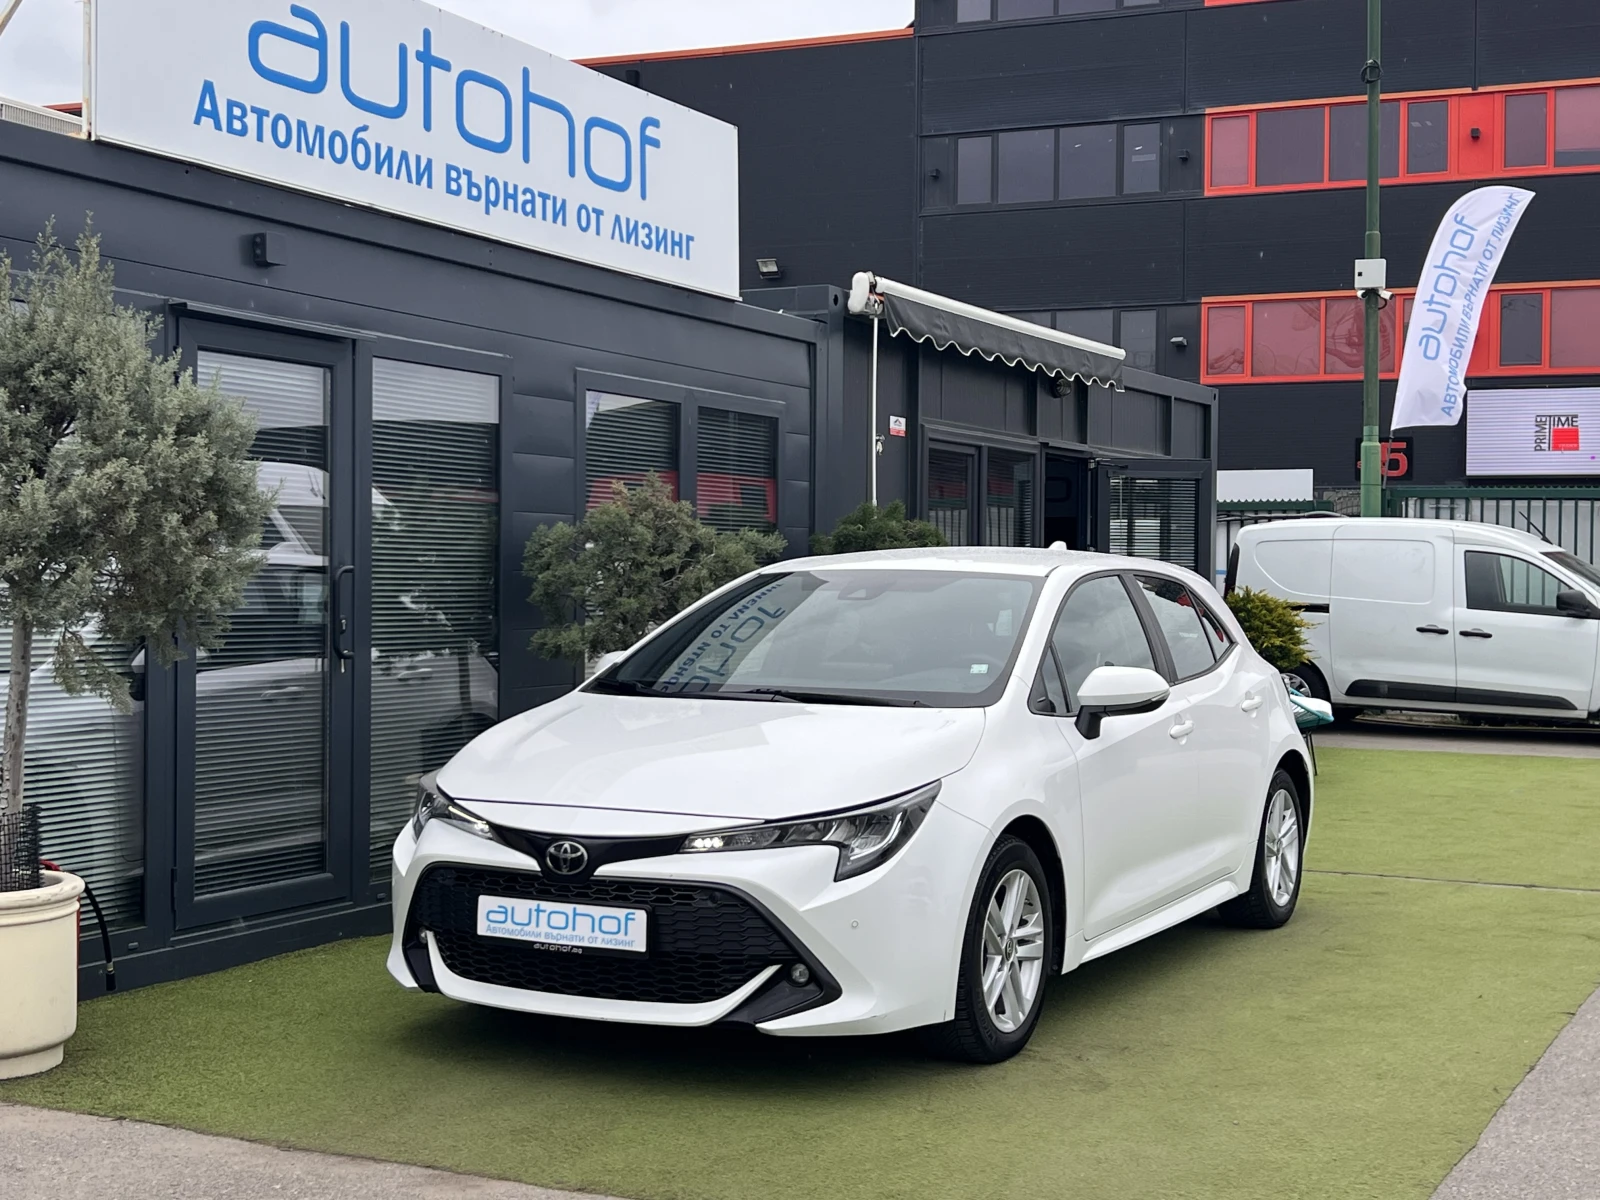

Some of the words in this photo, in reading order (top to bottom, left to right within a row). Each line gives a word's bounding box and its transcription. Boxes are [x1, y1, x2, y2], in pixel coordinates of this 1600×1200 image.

[193, 79, 433, 190] Автомобили
[445, 162, 568, 227] върнати
[576, 203, 605, 237] от
[611, 213, 695, 261] лизинг
[248, 3, 661, 201] autohof
[1418, 212, 1478, 361] autohof
[1440, 318, 1471, 418] АВТОМОБИЛИ
[1461, 260, 1490, 322] ВЪРНАТИ
[1482, 239, 1498, 261] ОТ
[1534, 416, 1547, 452] PRIME
[485, 923, 542, 939] Автомобили
[544, 930, 585, 944] върнати
[588, 934, 599, 945] от
[486, 903, 636, 937] autohof
